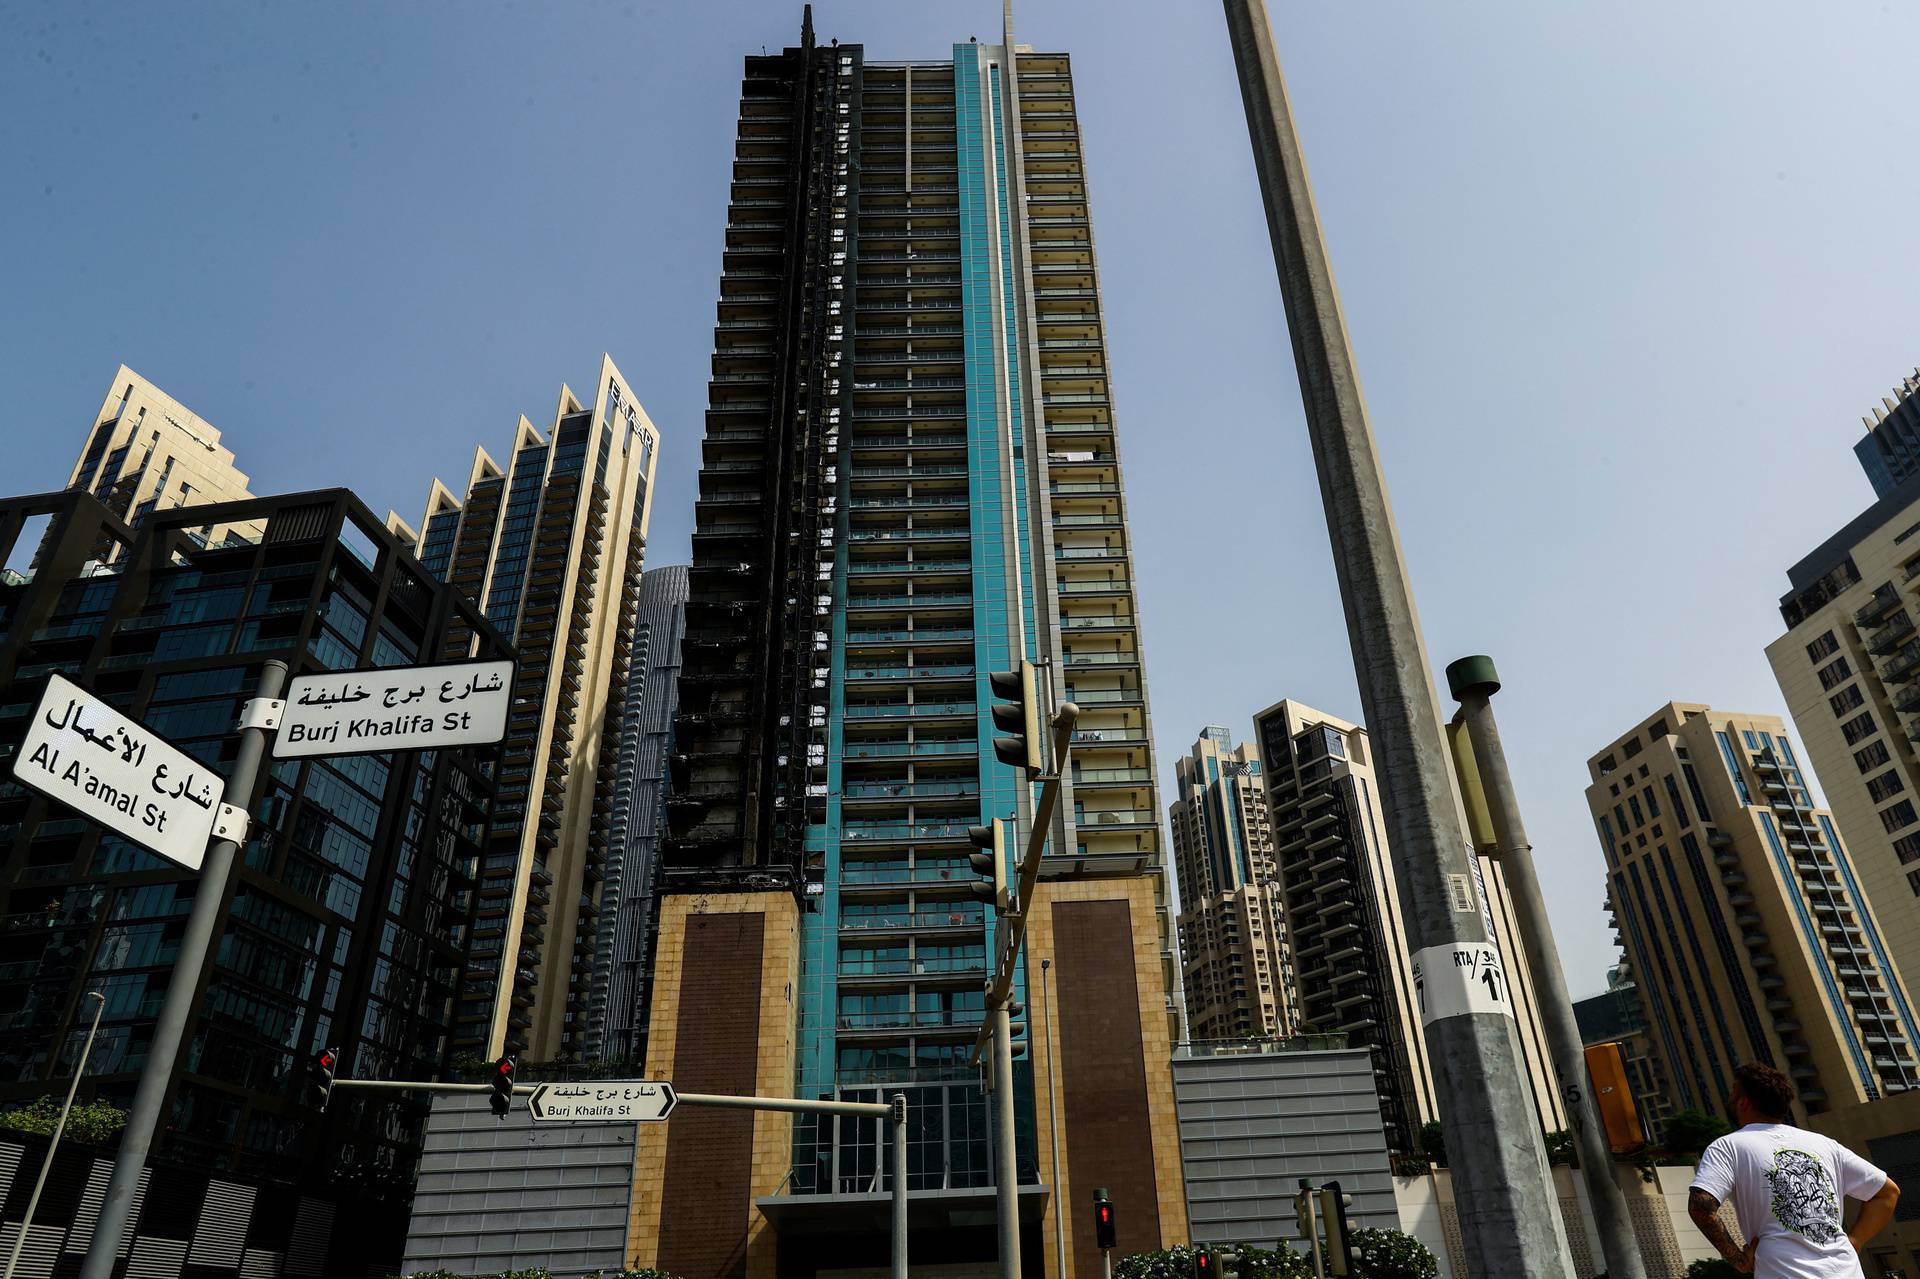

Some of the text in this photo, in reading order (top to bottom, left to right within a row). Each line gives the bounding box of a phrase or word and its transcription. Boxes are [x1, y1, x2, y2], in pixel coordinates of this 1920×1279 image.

[609, 378, 654, 455] EMAAR
[297, 672, 504, 710] شارع برج خليفة
[288, 711, 471, 744] Burj Khalifa St
[45, 699, 213, 810] شارع الأعمال
[29, 742, 167, 833] Al A'amal St
[547, 1105, 631, 1117] Burj Khalifa St
[553, 1086, 657, 1101] شارع برج خليفة
